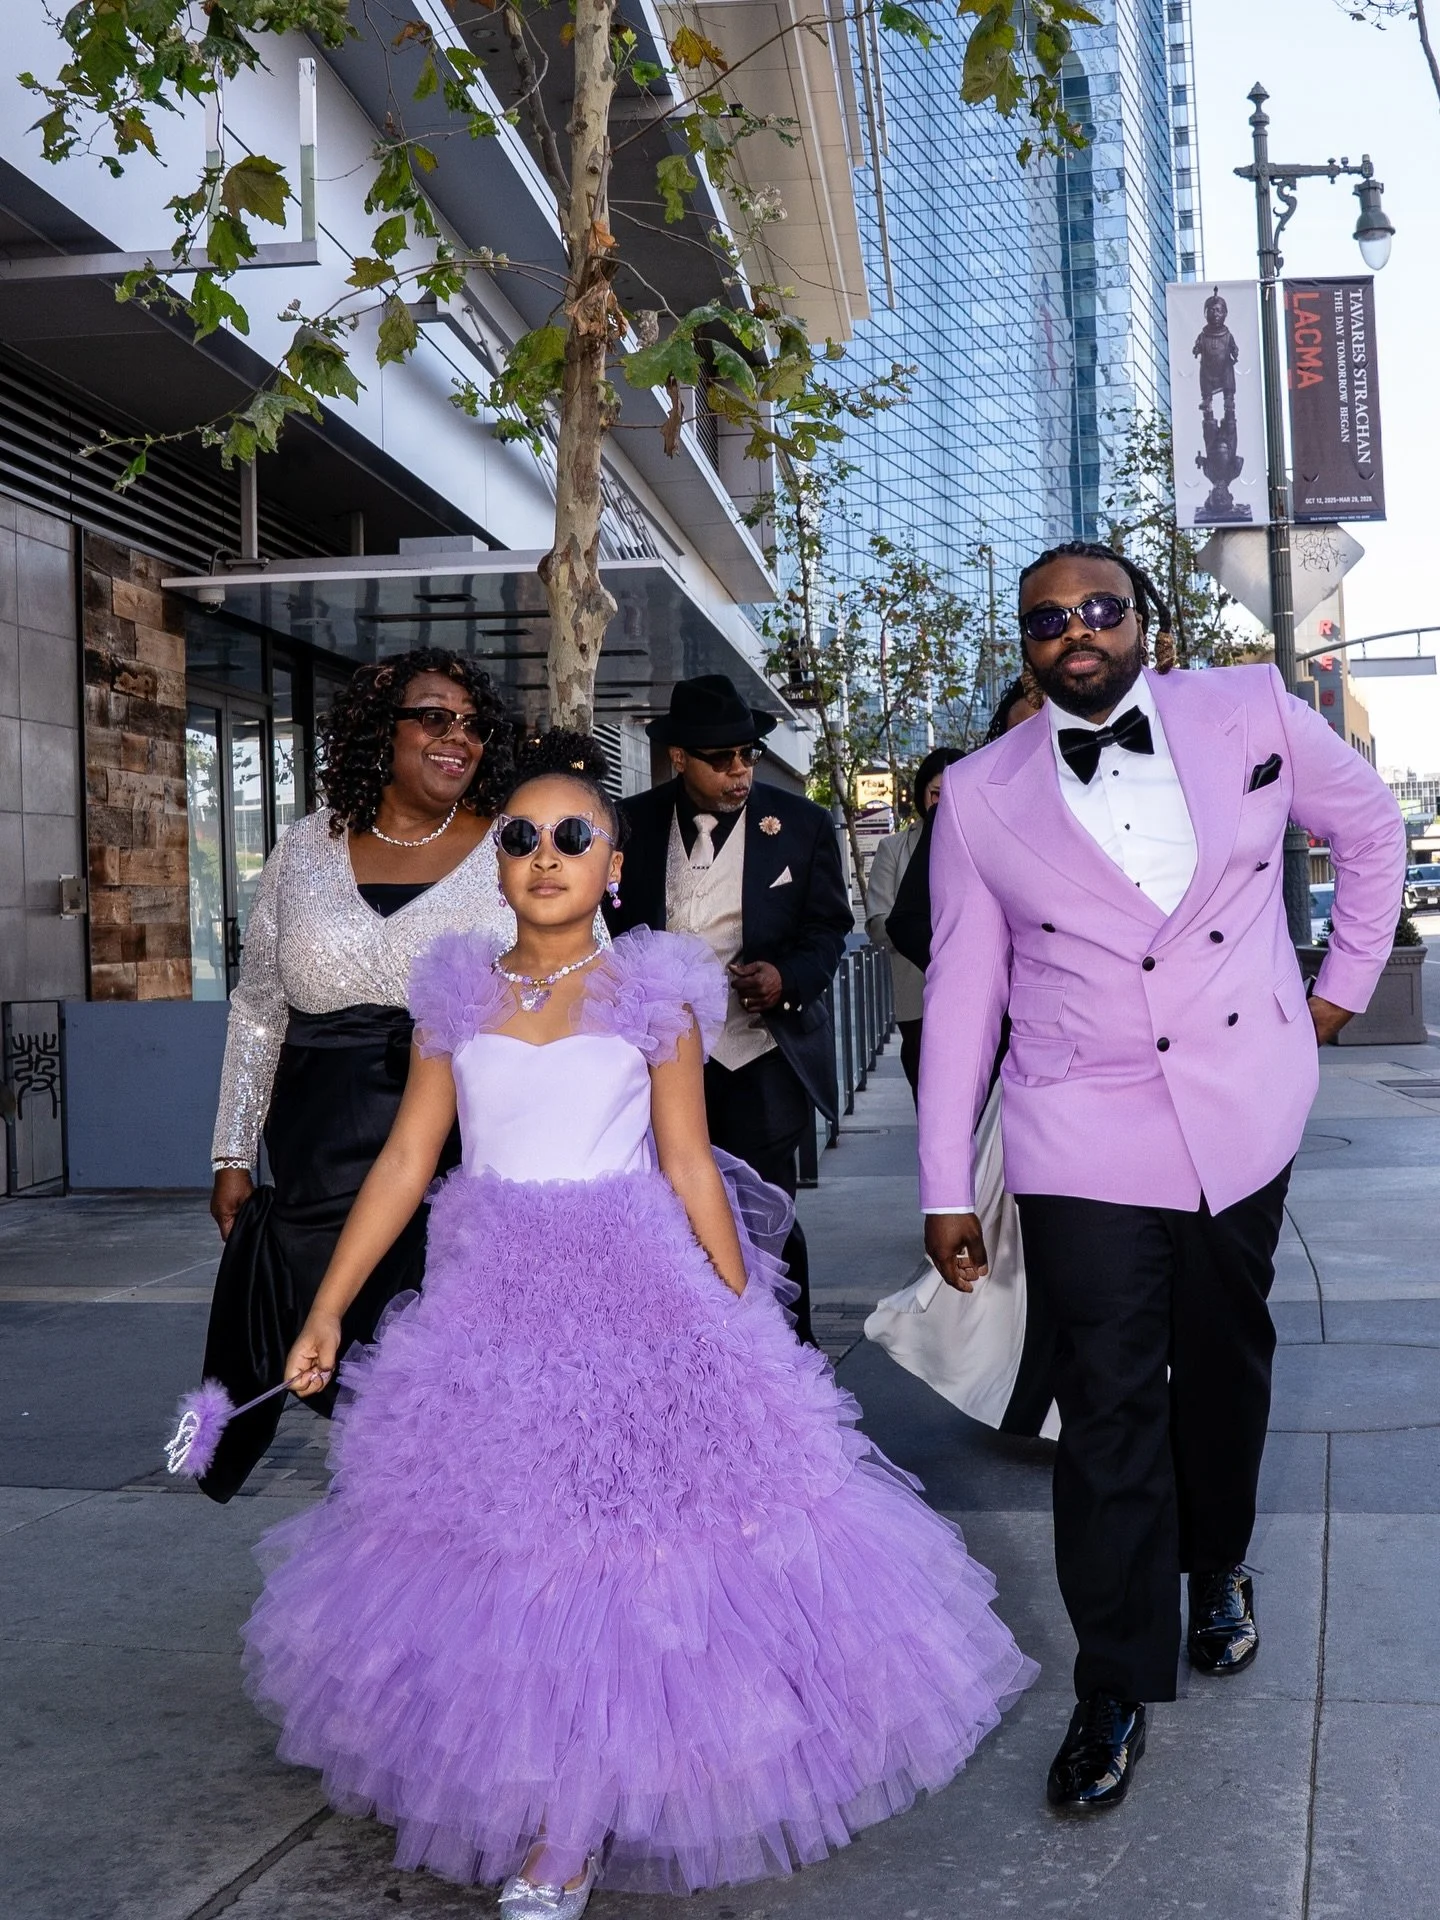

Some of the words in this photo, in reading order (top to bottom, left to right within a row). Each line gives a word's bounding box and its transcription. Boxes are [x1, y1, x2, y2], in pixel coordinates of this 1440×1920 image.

[1334, 289, 1344, 313] THE
[1335, 316, 1345, 336] DAY
[1350, 288, 1366, 363] TAVARES
[1293, 292, 1324, 389] LACMA
[1336, 339, 1348, 403] TOMORROW
[1340, 406, 1350, 443] BEGAN
[1353, 368, 1371, 464] STRACHAN
